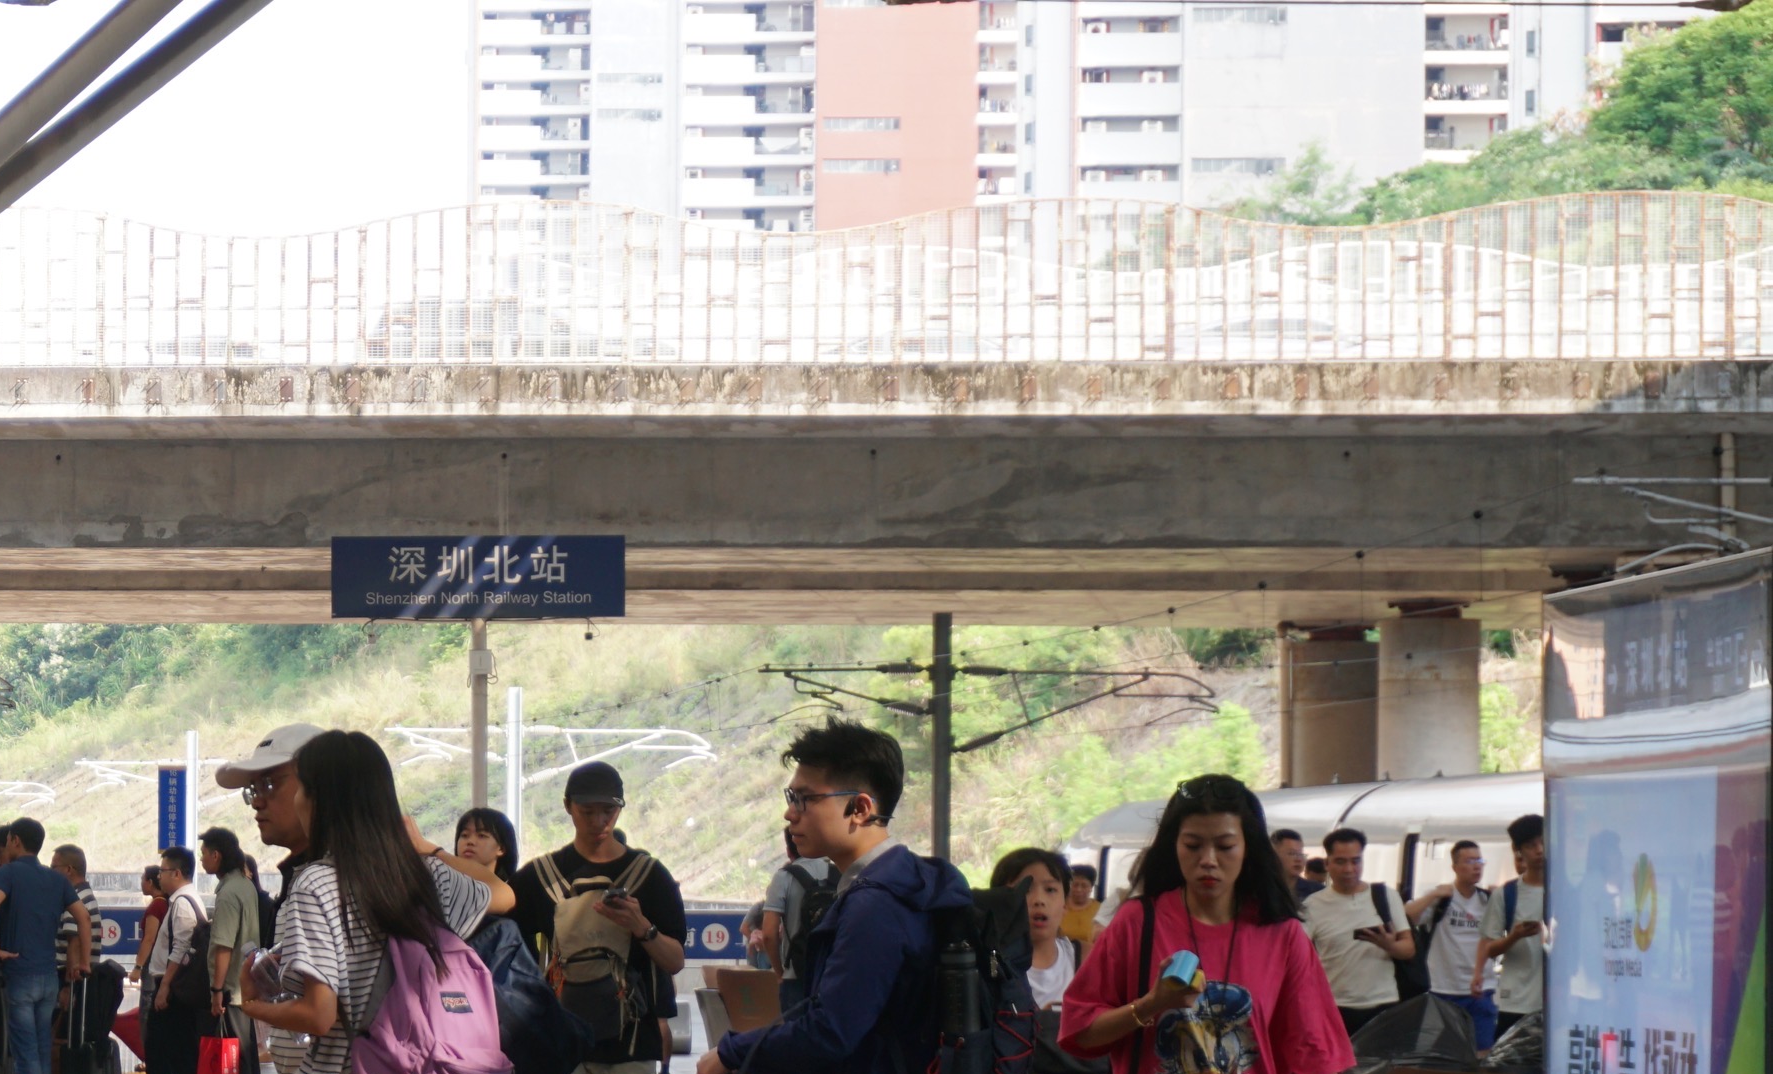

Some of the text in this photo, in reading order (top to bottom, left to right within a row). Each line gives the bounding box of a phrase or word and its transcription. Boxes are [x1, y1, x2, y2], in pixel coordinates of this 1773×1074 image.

[388, 545, 569, 584] 深圳北站
[365, 590, 592, 607] Shenzhen North Railway Station
[706, 930, 726, 944] 19
